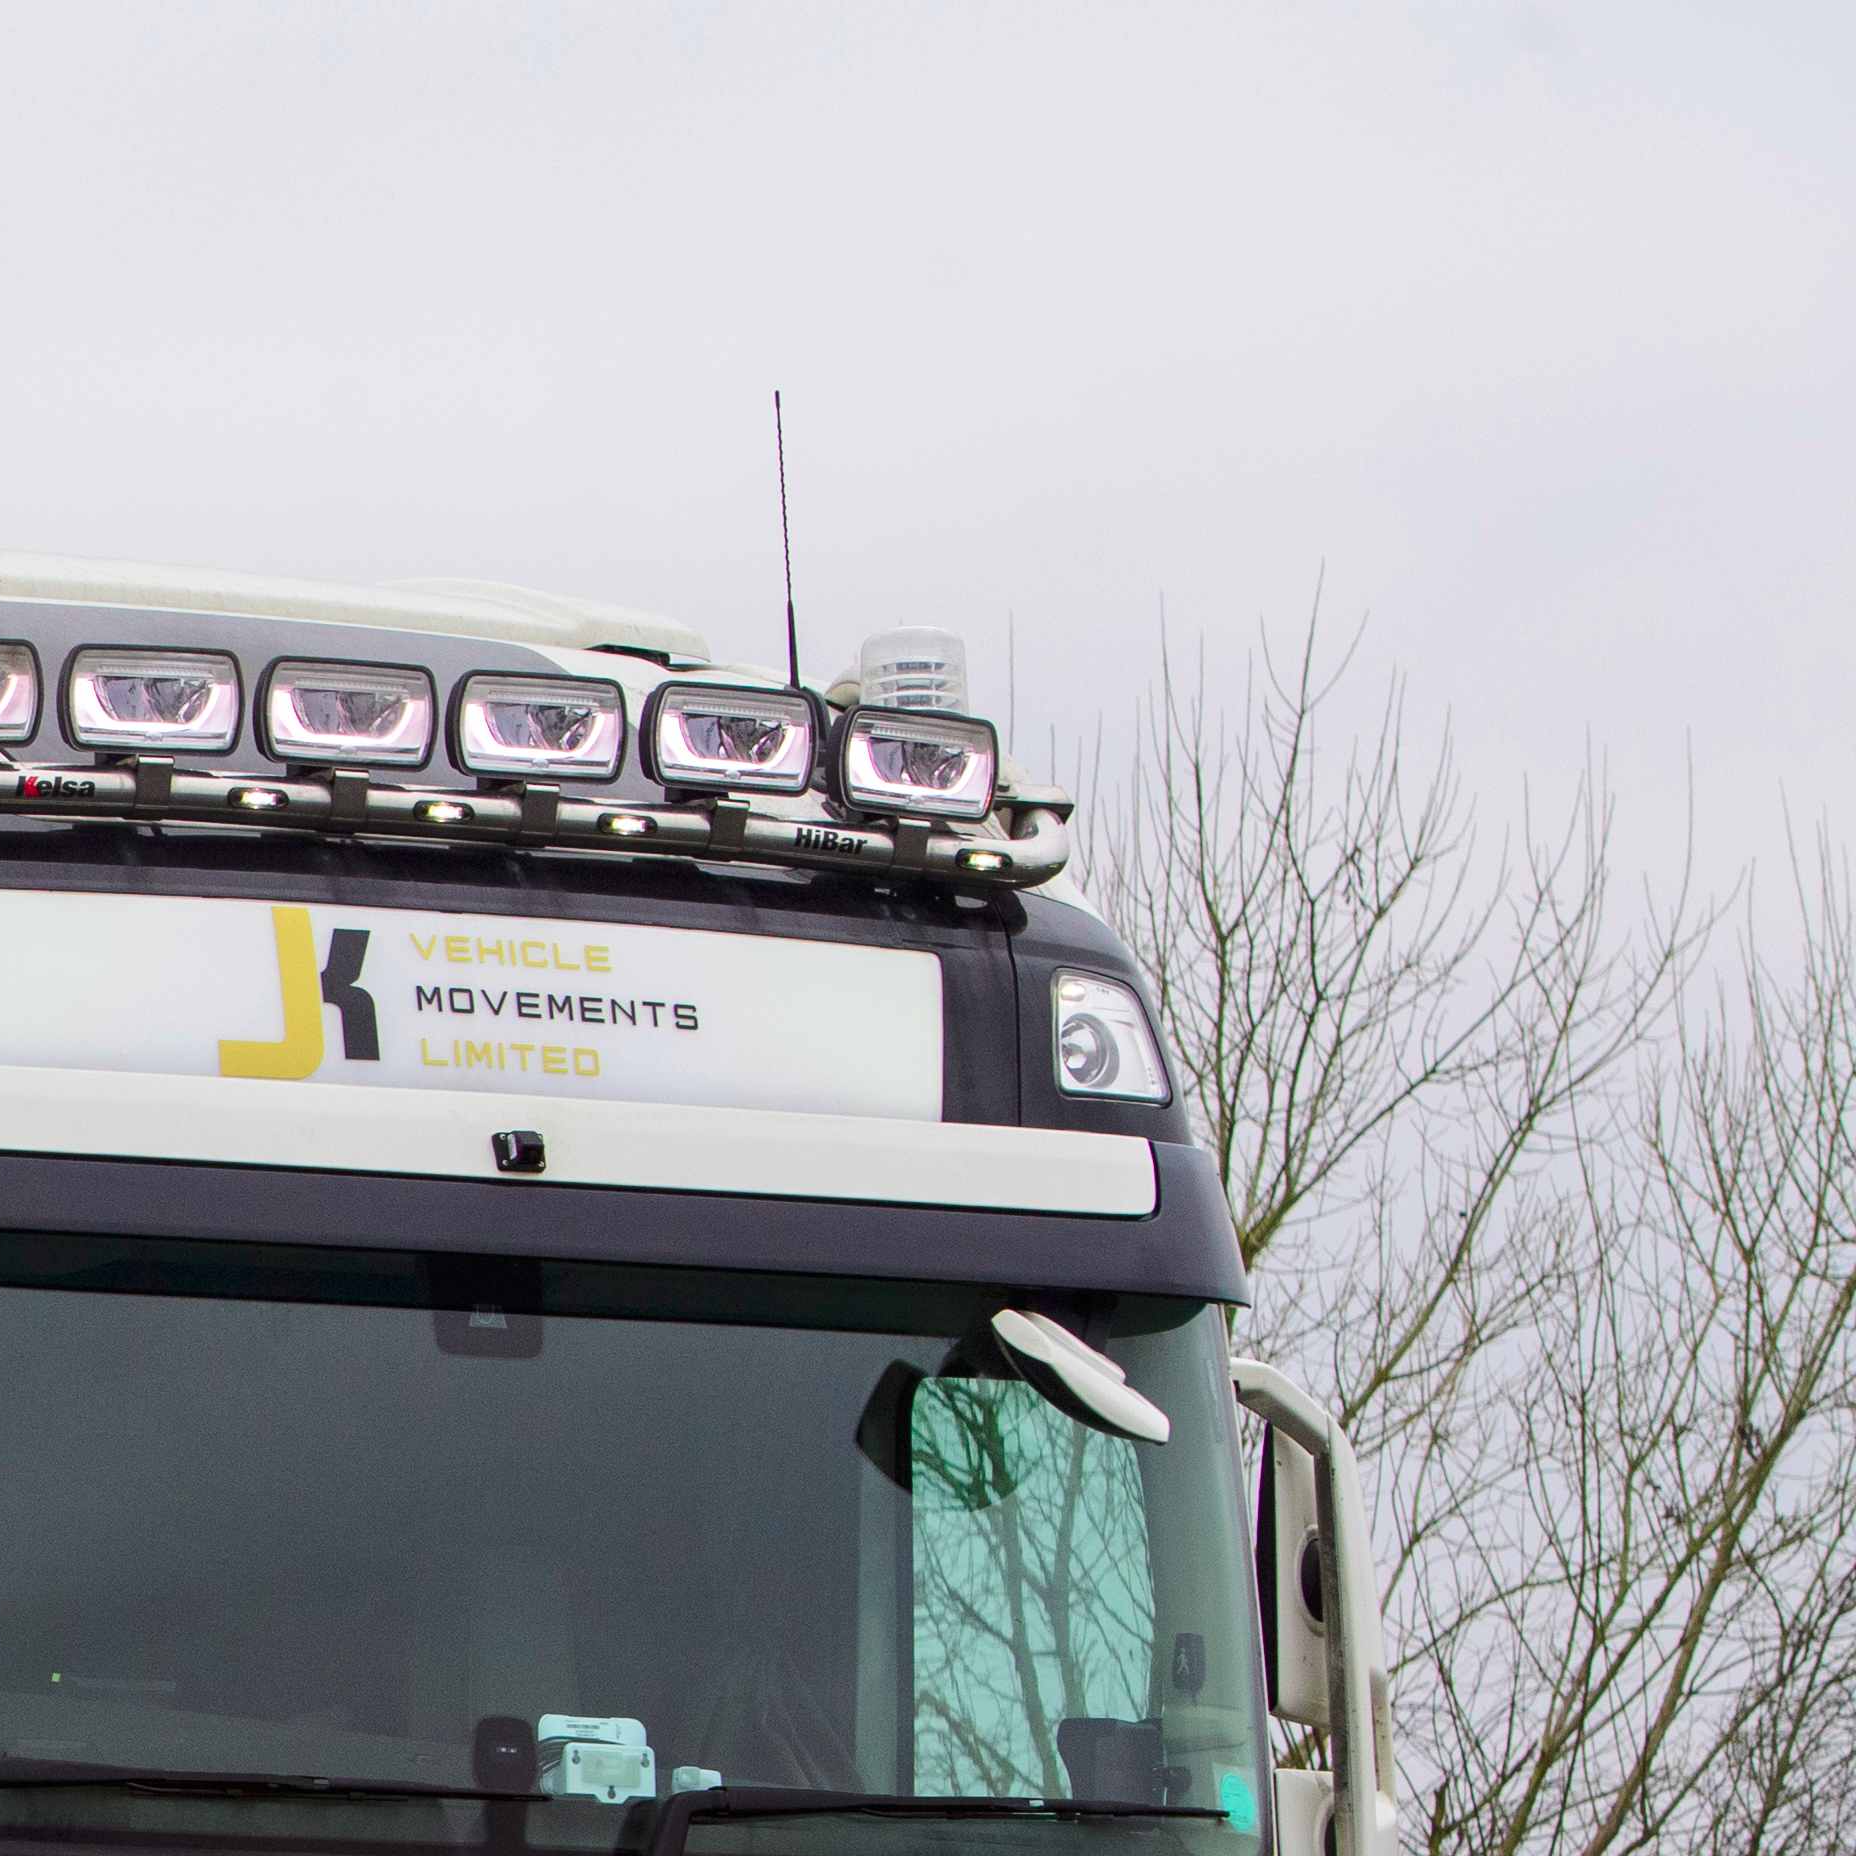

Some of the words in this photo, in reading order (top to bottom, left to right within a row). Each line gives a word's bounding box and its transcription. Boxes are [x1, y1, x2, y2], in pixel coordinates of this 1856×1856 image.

[17, 774, 96, 799] Kelsa
[795, 826, 868, 856] HiBar
[409, 931, 614, 974] VEHICLE
[415, 984, 699, 1031] MOVEMENTS
[420, 1038, 601, 1078] LIMITED
